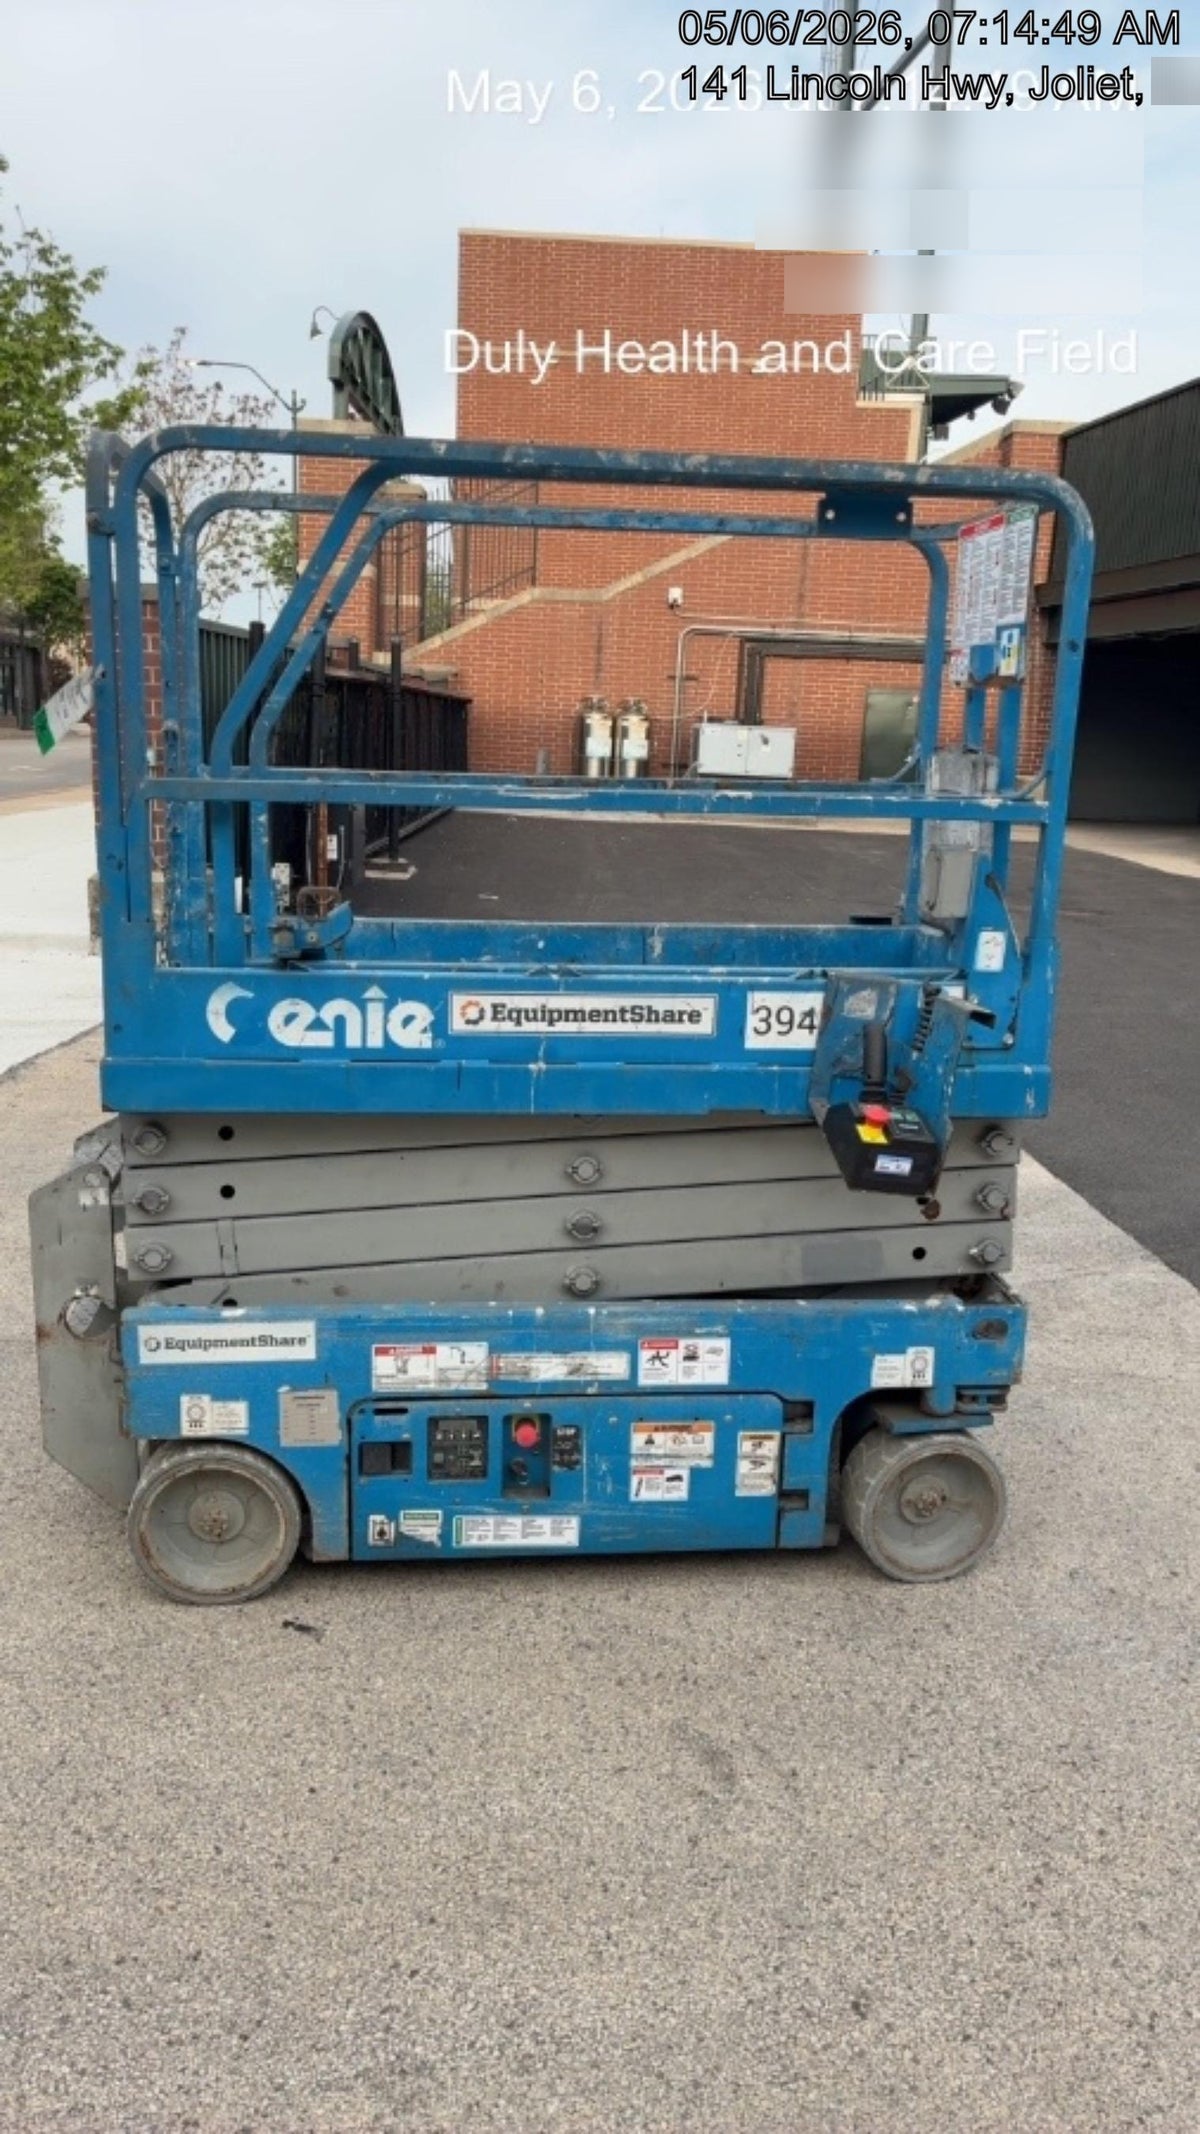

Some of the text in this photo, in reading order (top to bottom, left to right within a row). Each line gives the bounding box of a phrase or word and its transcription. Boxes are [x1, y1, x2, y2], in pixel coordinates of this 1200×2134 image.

[490, 1003, 703, 1027] EquipmentShare
[752, 1005, 816, 1036] 394
[163, 1334, 307, 1352] EquipmentShare
